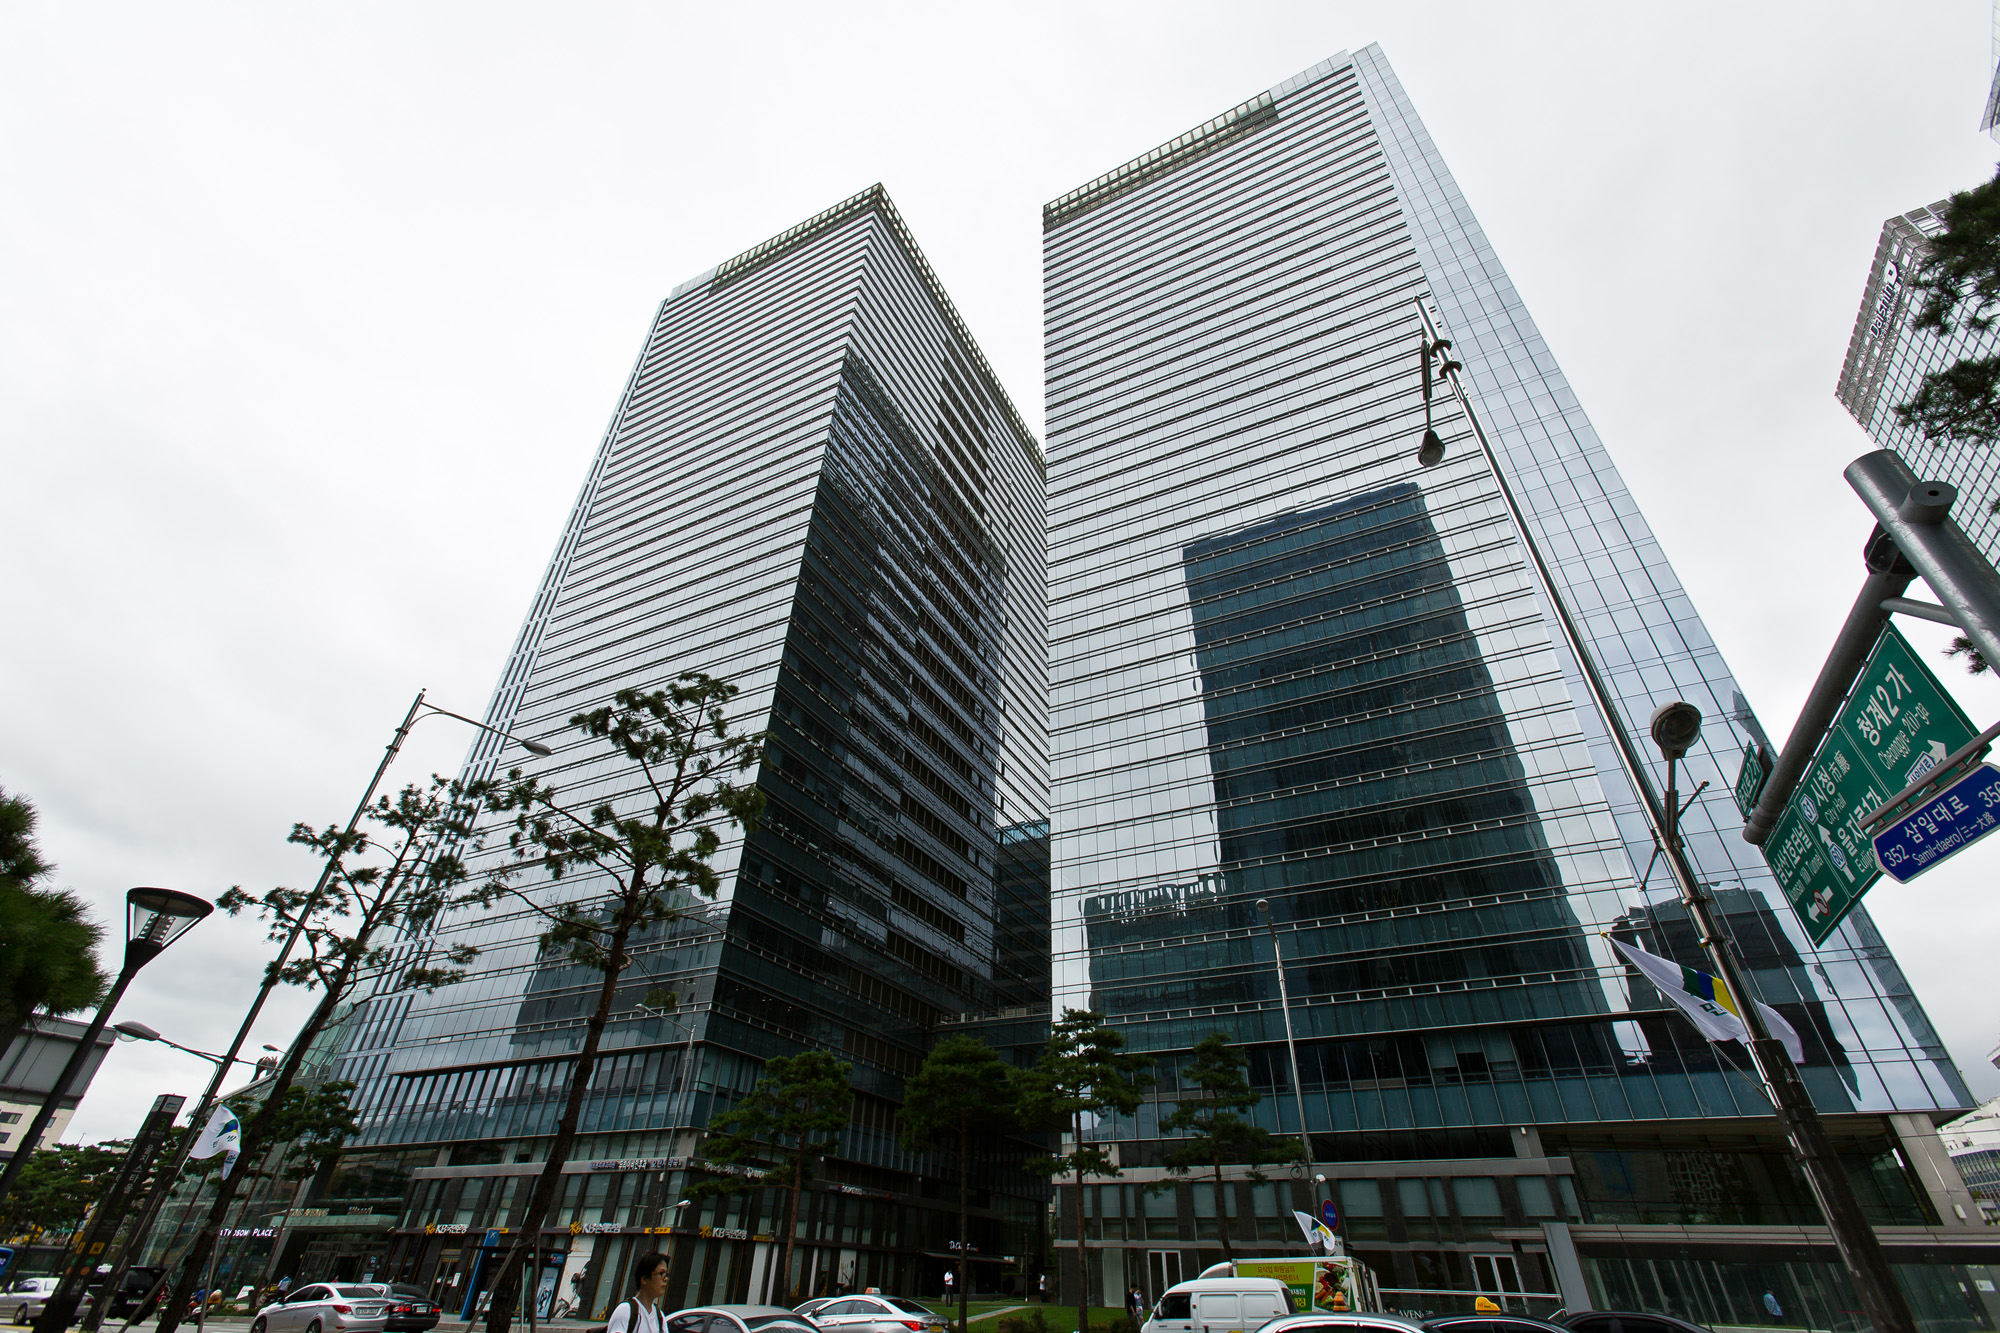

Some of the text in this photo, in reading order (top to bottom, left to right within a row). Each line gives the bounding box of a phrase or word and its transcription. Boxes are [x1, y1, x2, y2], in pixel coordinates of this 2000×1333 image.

[1870, 283, 1894, 338] Daishin
[1856, 663, 1912, 746] 청계2가
[1878, 702, 1930, 770] Cheonggye 2(i)-ga
[1811, 764, 1836, 807] 시청
[1825, 792, 1847, 825] City Hall
[1904, 795, 1970, 844] 삼일대로
[1772, 819, 1813, 886] 남산1호터널
[1884, 844, 1910, 867] 352
[252, 1228, 274, 1237] PLACE
[712, 1227, 748, 1240] KB국민은행
